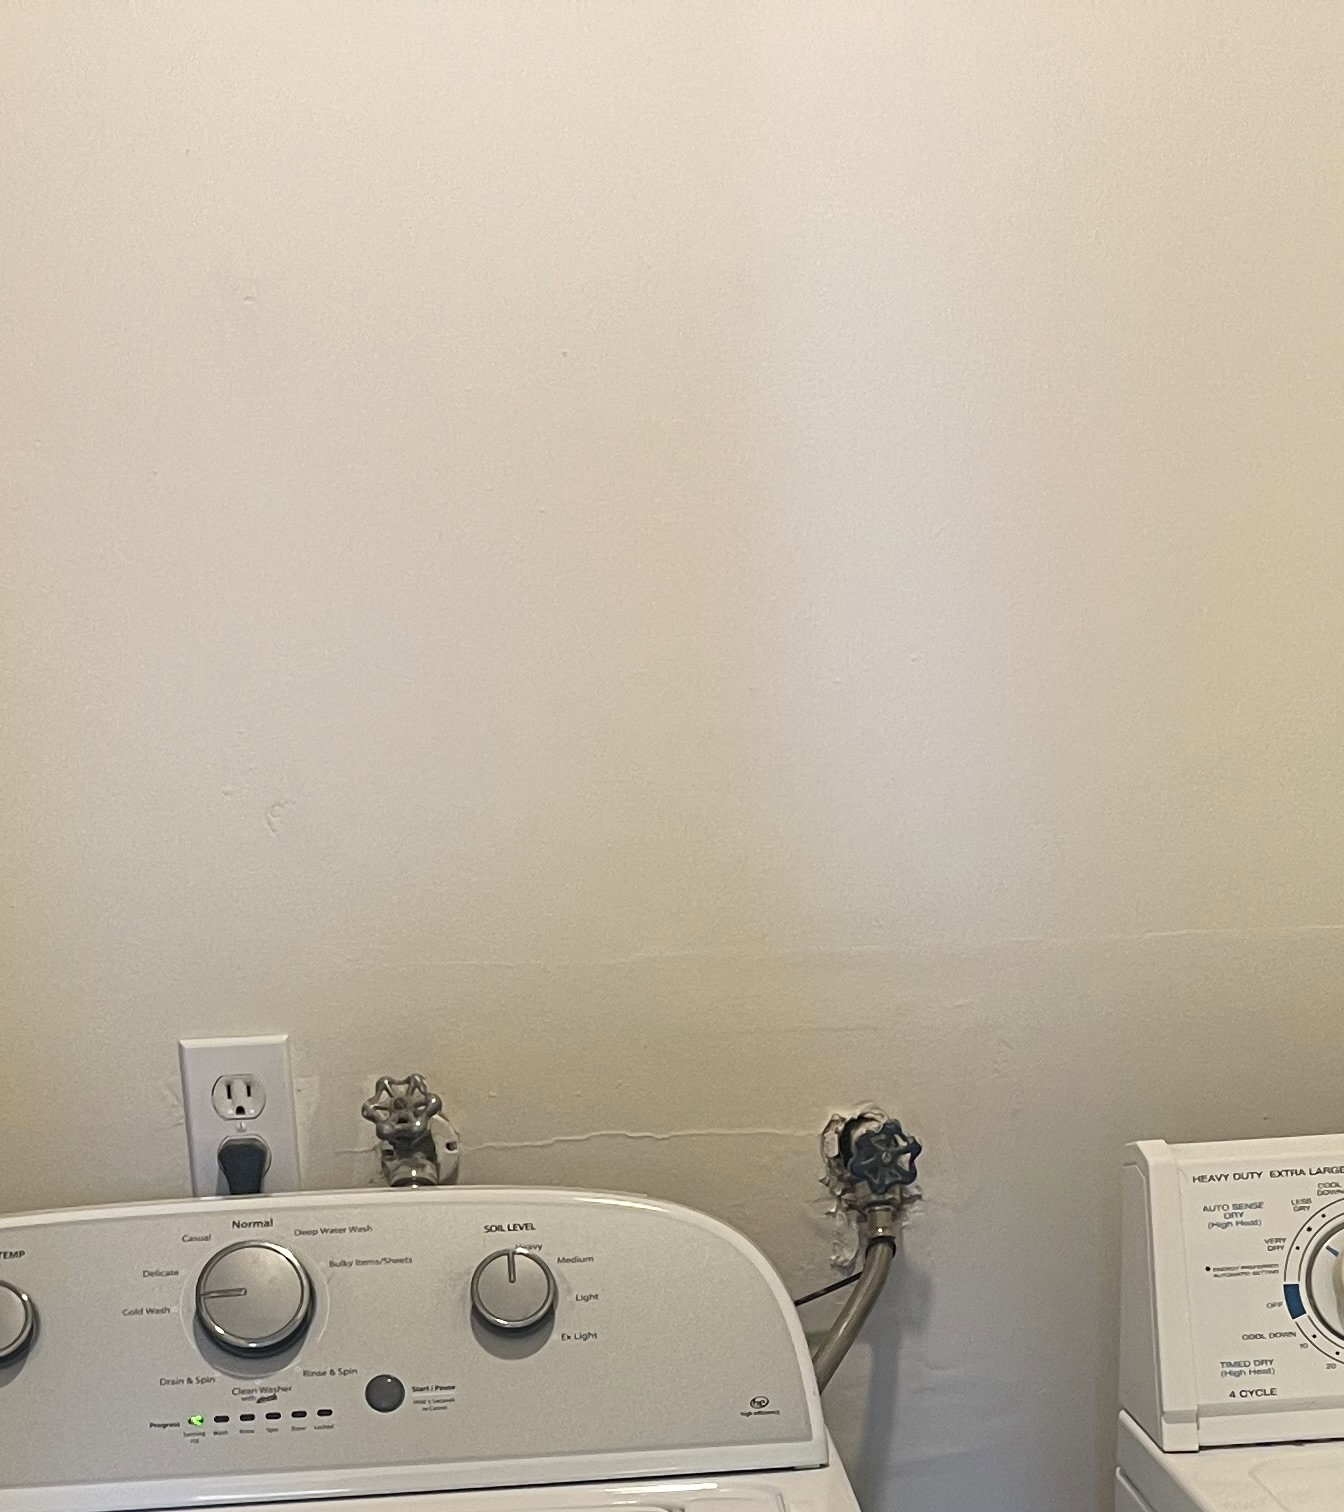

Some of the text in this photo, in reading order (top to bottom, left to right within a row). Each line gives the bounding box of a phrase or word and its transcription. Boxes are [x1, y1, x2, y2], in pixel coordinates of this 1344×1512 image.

[1193, 1174, 1229, 1183] HEAVY
[1233, 1171, 1263, 1181] DUTY
[1269, 1169, 1306, 1178] EXTRA
[1202, 1201, 1264, 1212] AUTO SENSE
[1224, 1211, 1244, 1219] DRY
[232, 1218, 274, 1229] Normal
[484, 1222, 537, 1233] SOIL LEVEL
[294, 1229, 318, 1237] Deep
[348, 1225, 373, 1233] Wash
[182, 1233, 212, 1242] Casual
[329, 1260, 353, 1268] Bulky
[557, 1256, 594, 1264] Medium
[142, 1269, 179, 1278] Delicate
[575, 1294, 599, 1303] Light
[121, 1307, 171, 1316] Cold Wash
[574, 1331, 598, 1341] Light
[1219, 1360, 1251, 1368] TIMED
[303, 1367, 358, 1377] Rinse & Spin
[159, 1376, 216, 1386] Drain & Spin
[232, 1384, 292, 1396] Clean Washer
[1229, 1388, 1278, 1398] 4 CYCLE
